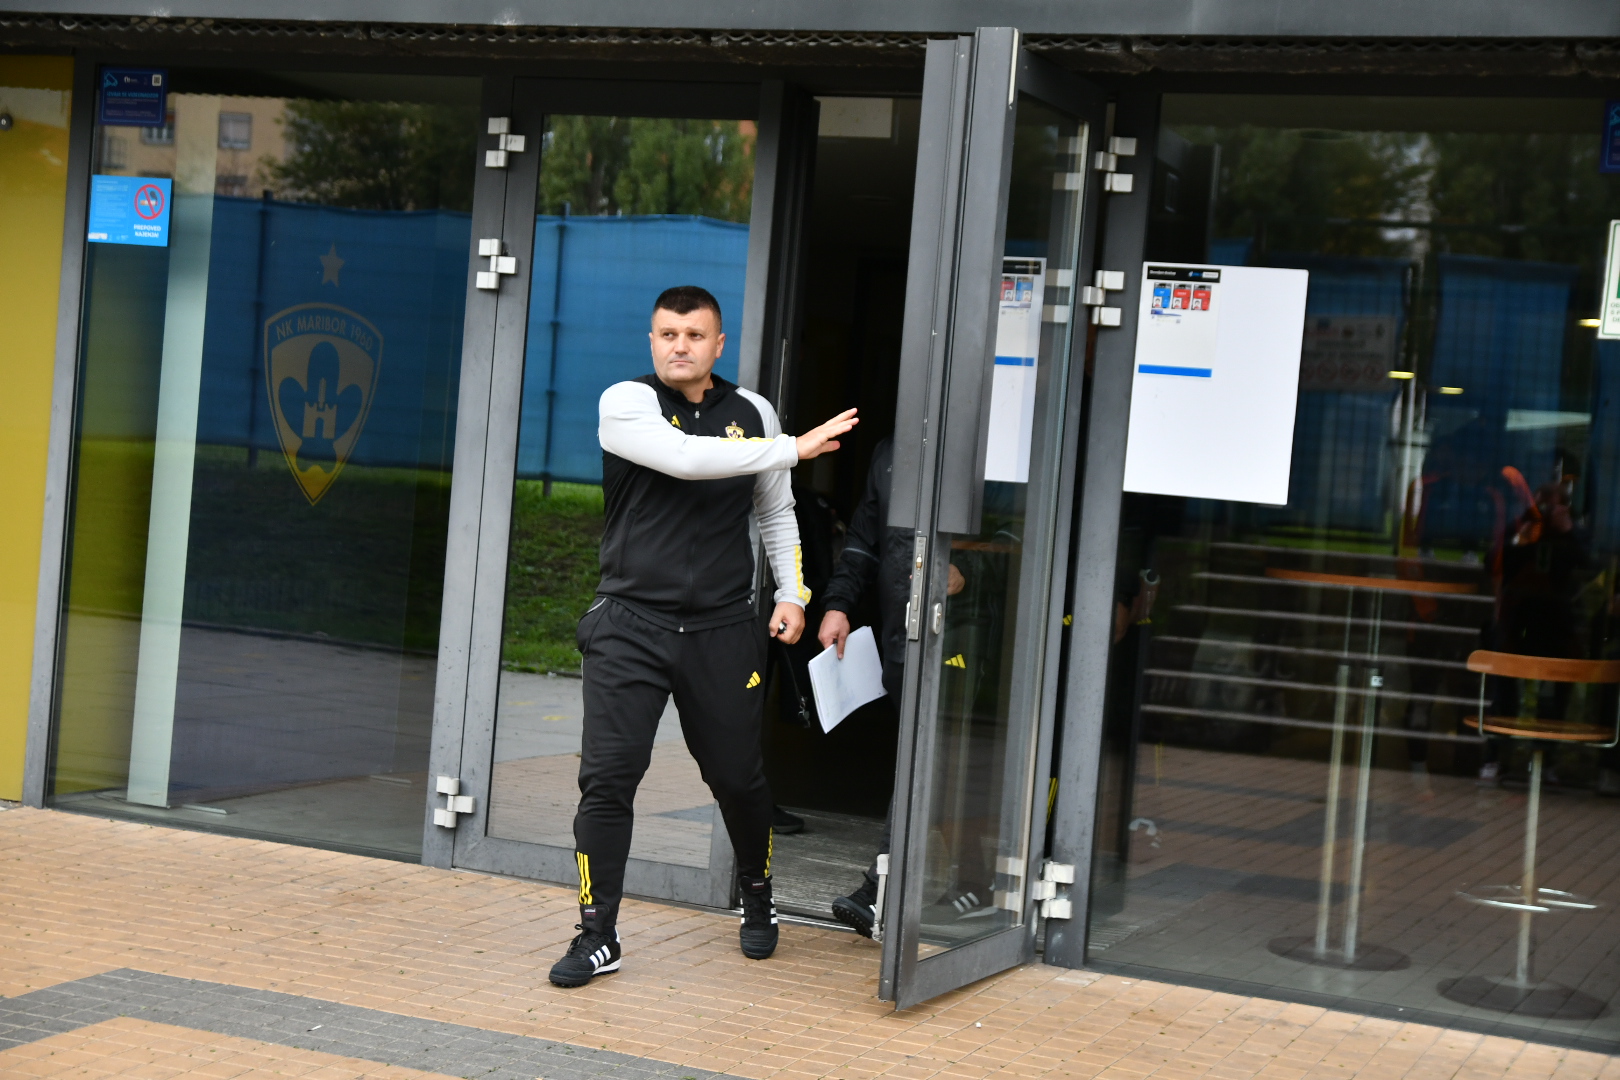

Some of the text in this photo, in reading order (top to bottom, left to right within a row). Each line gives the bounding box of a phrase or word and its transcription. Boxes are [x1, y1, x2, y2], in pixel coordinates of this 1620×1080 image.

[276, 315, 373, 351] NK MARIBOR 1960
